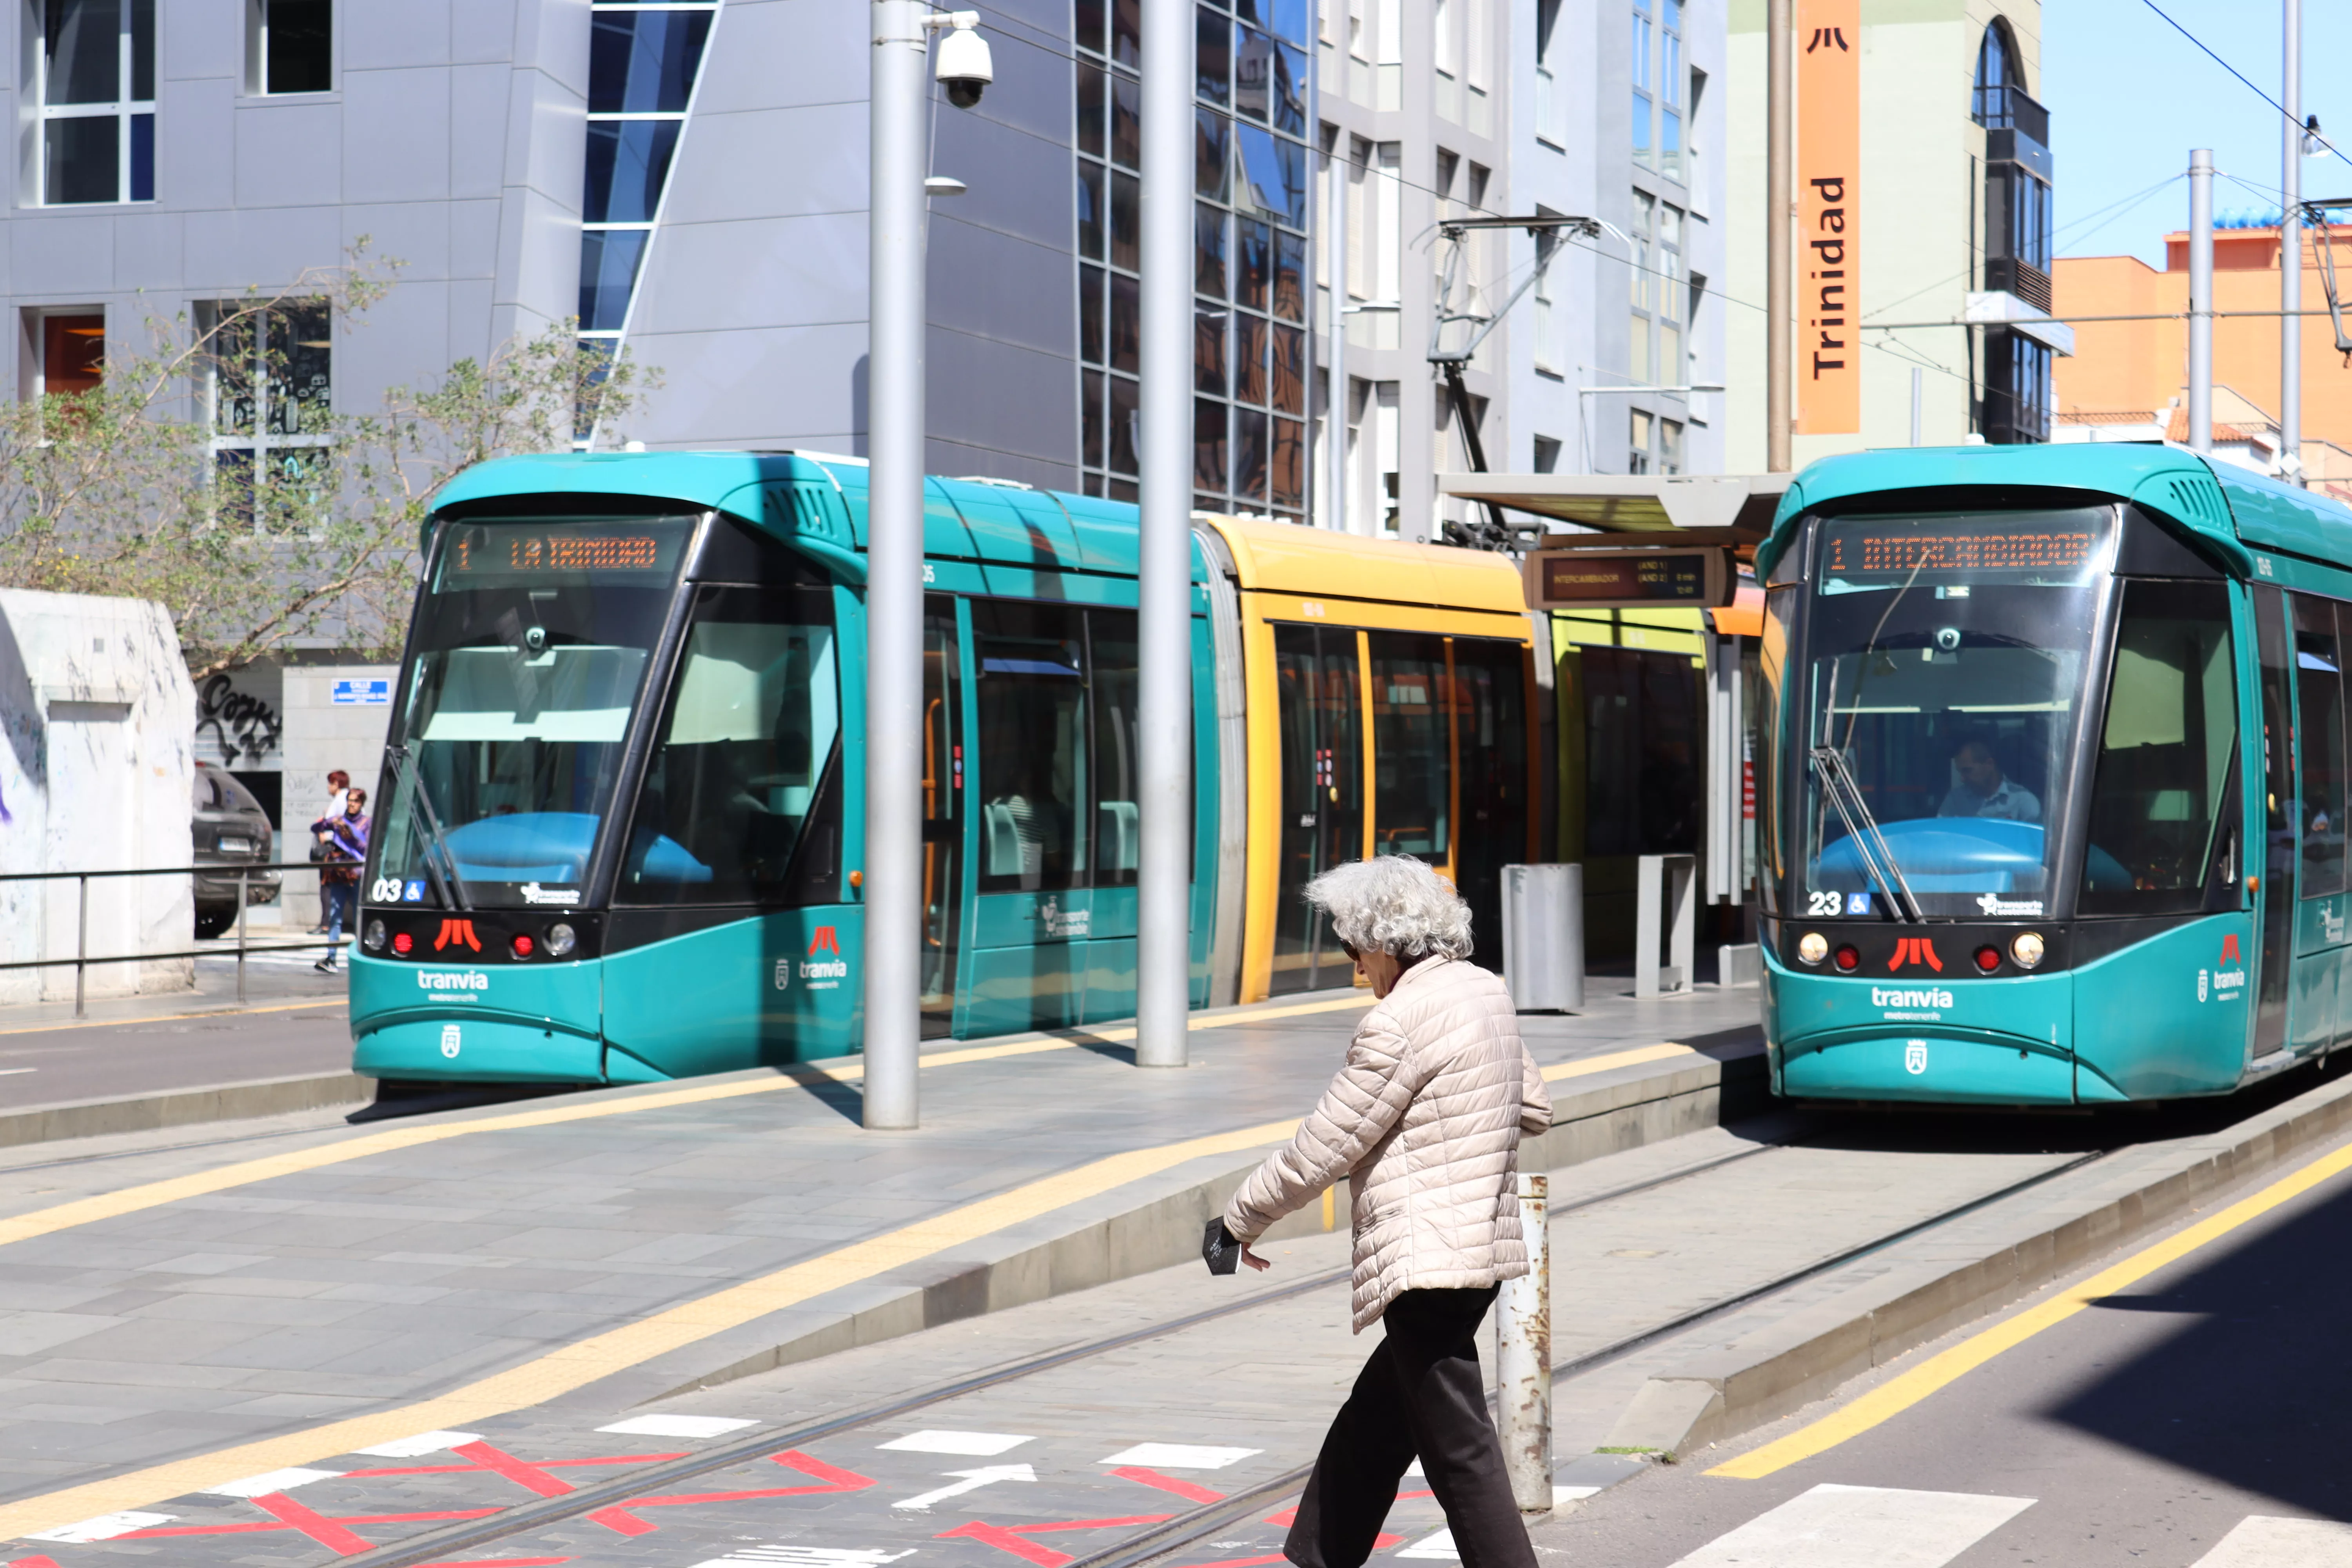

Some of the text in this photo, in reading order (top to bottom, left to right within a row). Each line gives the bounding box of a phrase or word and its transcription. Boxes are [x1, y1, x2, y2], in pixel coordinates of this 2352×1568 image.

[1811, 177, 1845, 381] Trinidad
[457, 537, 471, 570] 1
[547, 536, 656, 570] TRINIDAD
[1831, 538, 1846, 570] 1
[372, 878, 403, 903] 03
[1808, 891, 1842, 916] 23
